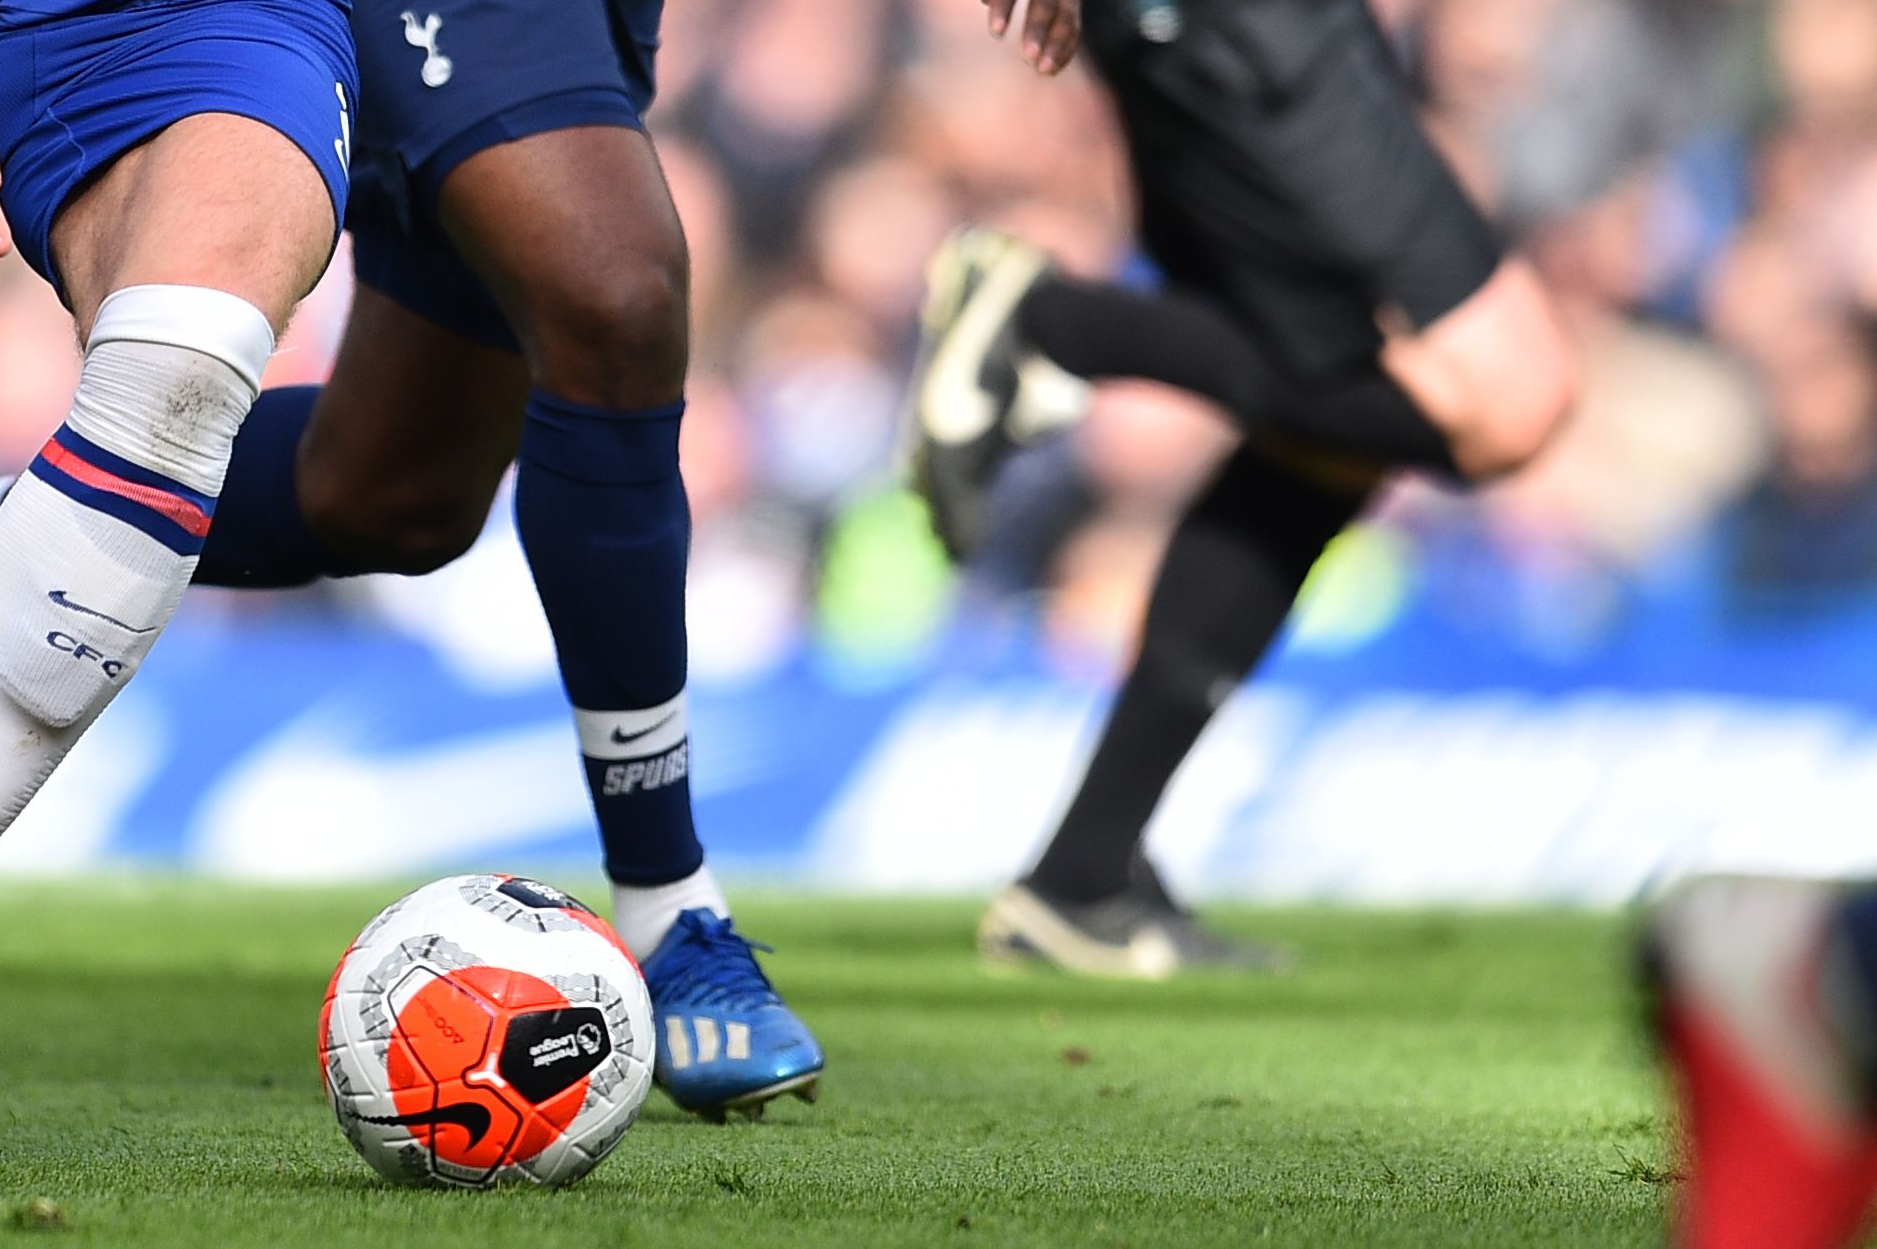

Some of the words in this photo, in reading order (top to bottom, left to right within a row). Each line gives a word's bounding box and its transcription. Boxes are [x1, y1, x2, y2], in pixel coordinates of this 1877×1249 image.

[46, 631, 129, 678] CFC
[603, 744, 687, 795] SPURS
[529, 1034, 575, 1056] League
